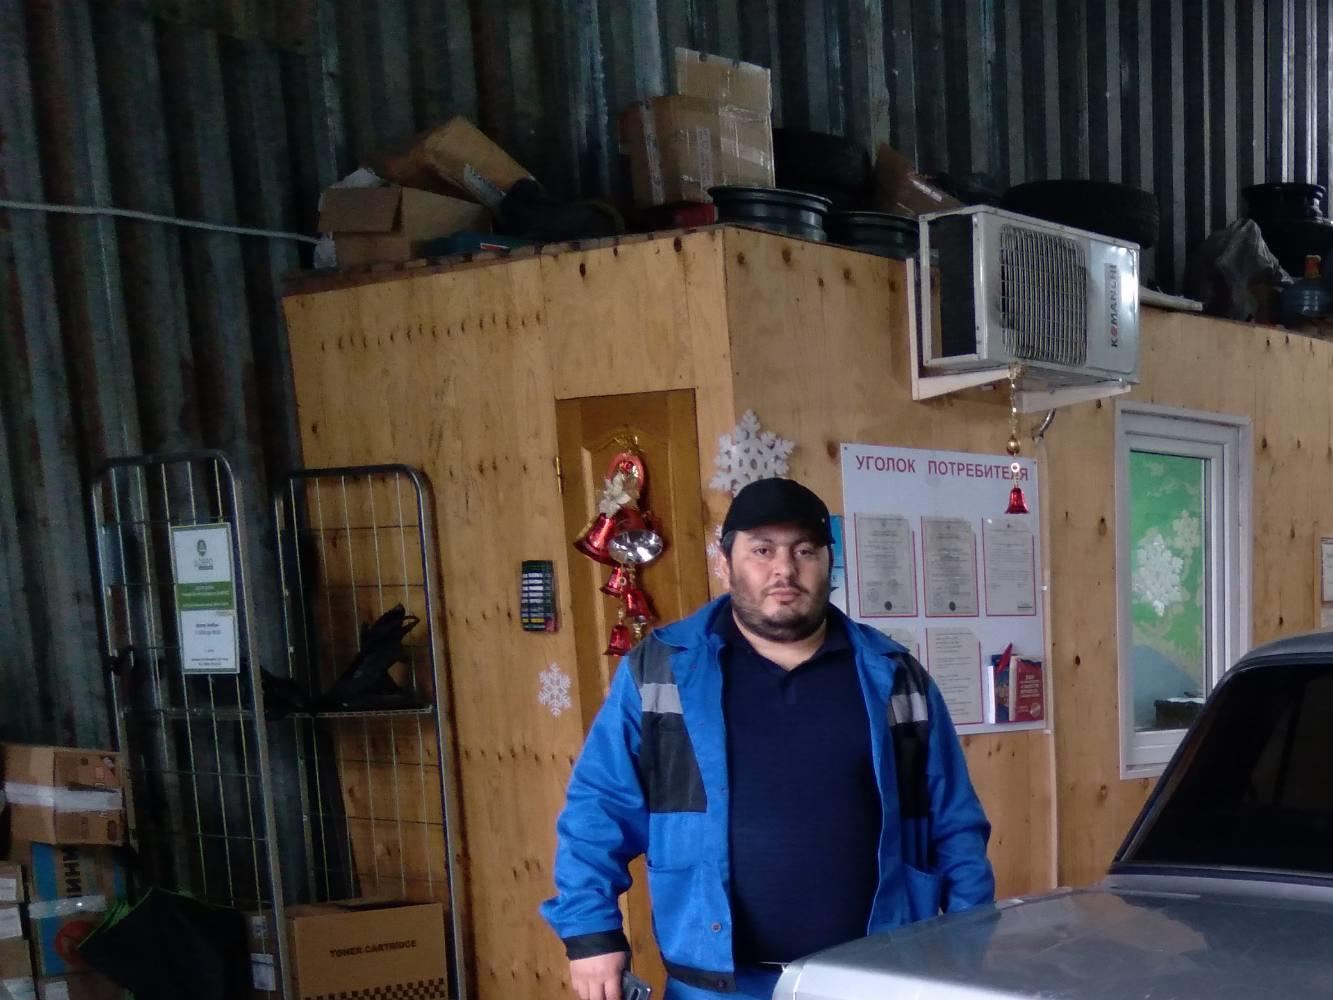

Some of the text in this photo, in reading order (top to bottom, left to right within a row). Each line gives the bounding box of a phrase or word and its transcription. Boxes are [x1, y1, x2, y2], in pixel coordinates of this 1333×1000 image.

[855, 454, 917, 475] УГОЛОК
[328, 938, 417, 959] TONER CARTRIDGE
